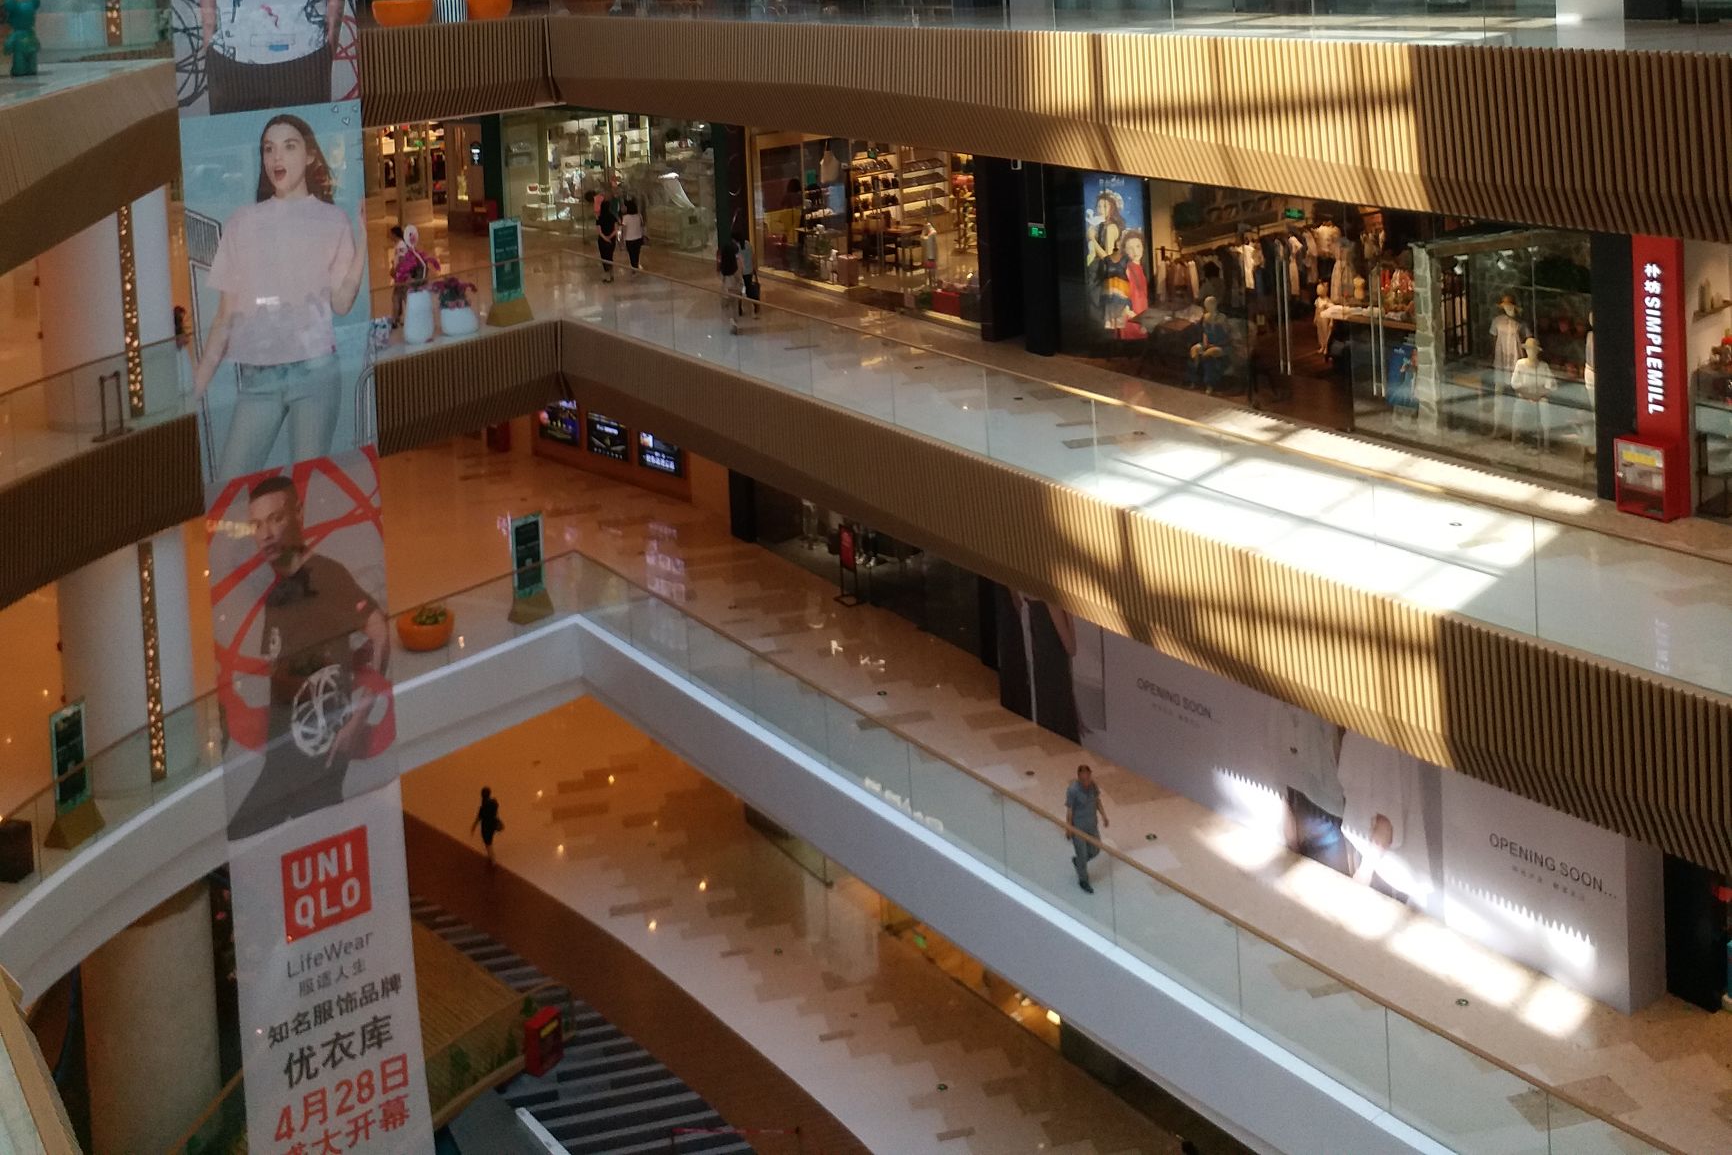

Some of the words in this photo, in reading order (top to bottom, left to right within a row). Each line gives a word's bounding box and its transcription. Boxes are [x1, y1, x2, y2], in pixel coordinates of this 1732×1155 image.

[1644, 296, 1665, 415] SIMPLEMILL
[291, 841, 354, 890] UNI
[1489, 832, 1556, 872] OPENING
[294, 876, 362, 929] QLO
[287, 932, 374, 979] LifeWear
[267, 972, 403, 1048] 知名服饰品牌
[283, 1013, 394, 1089] 优衣库
[274, 1052, 410, 1143] 4月28日
